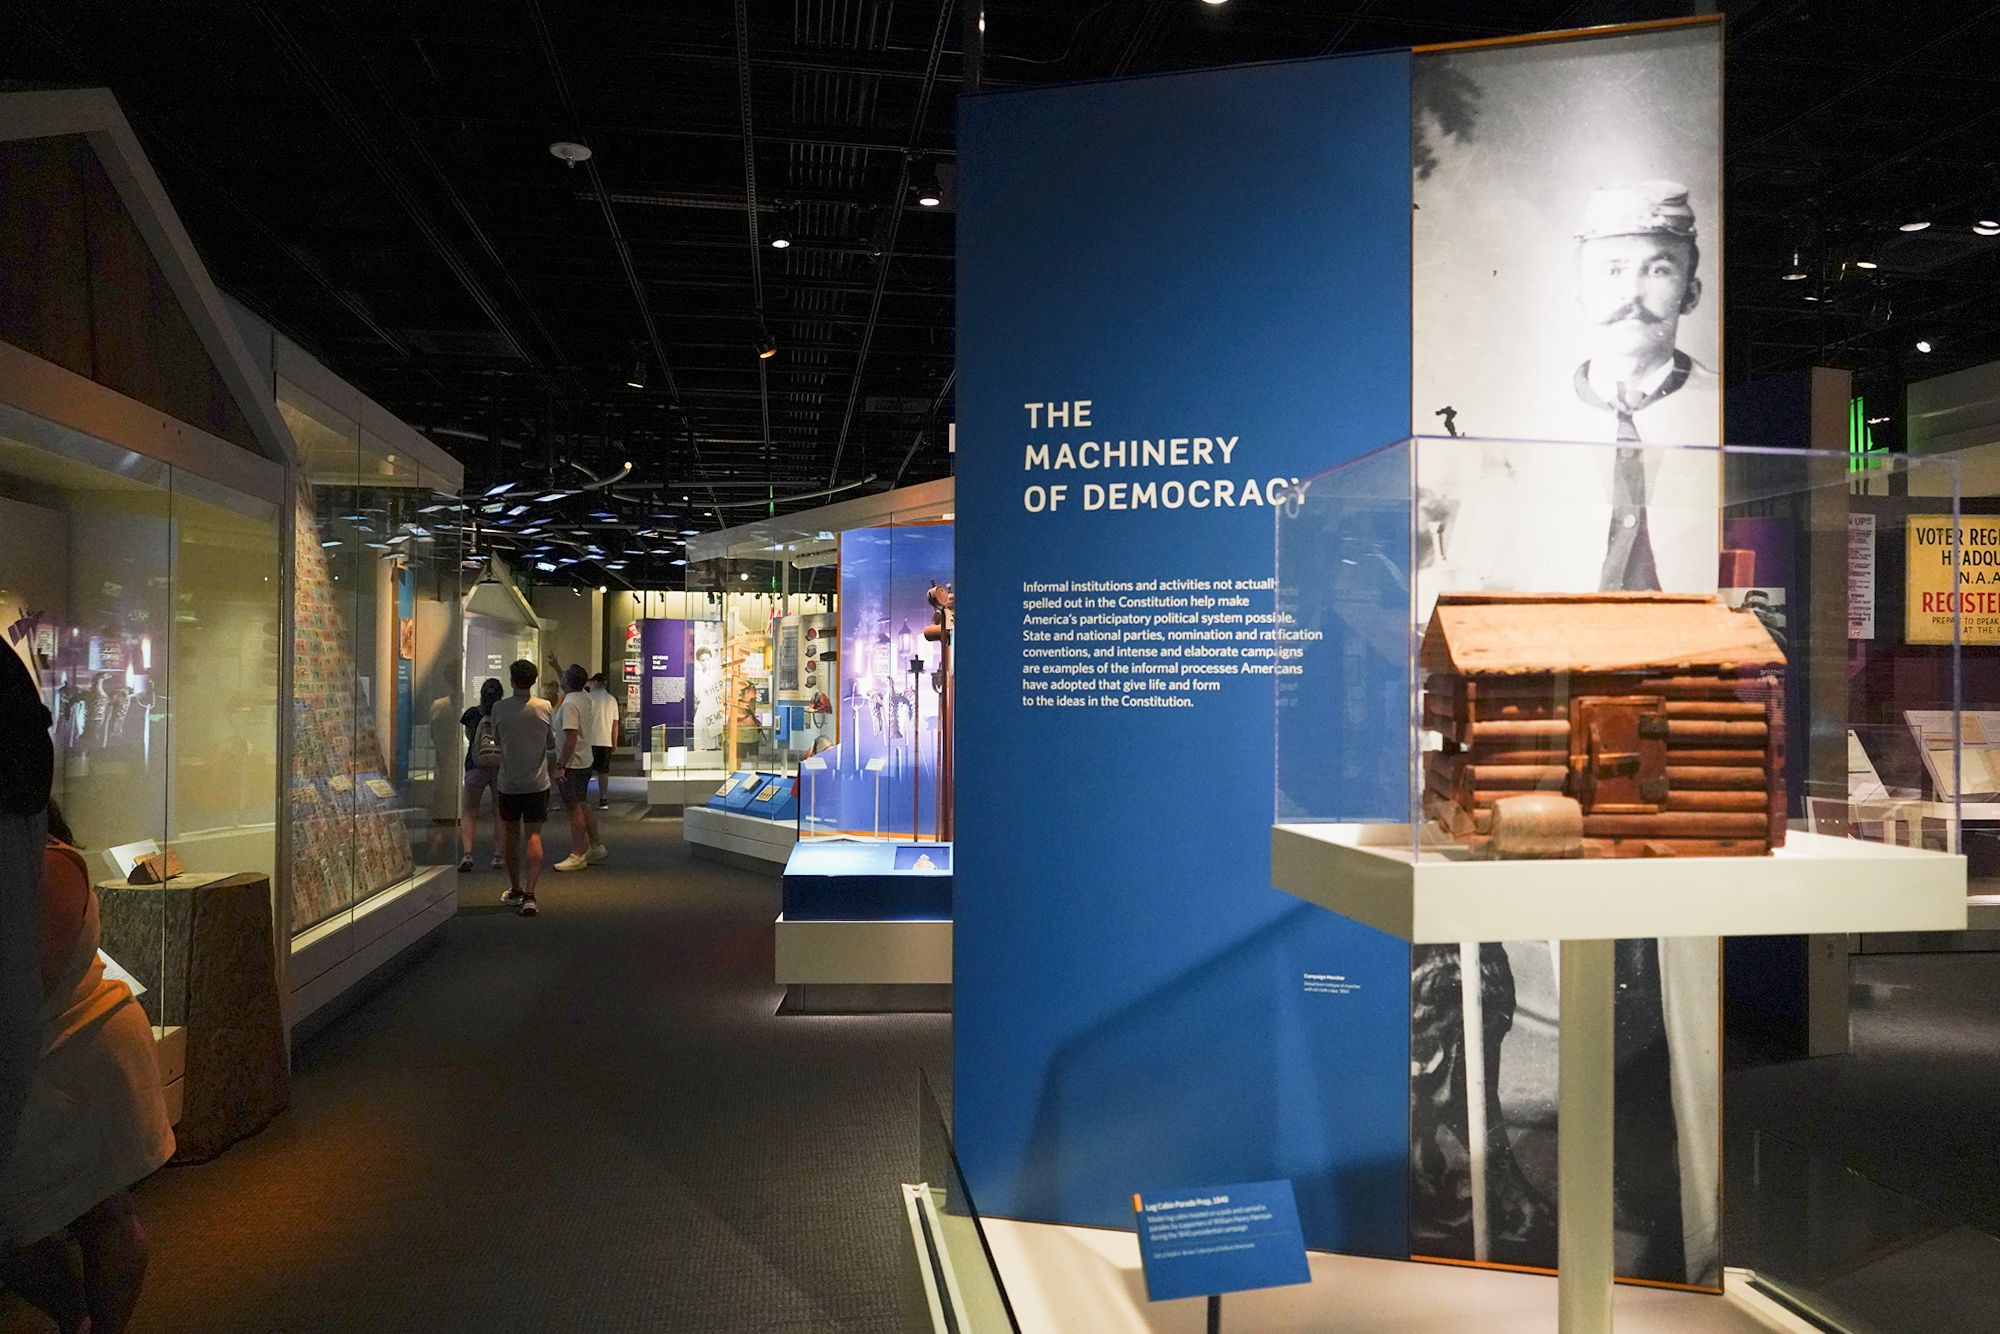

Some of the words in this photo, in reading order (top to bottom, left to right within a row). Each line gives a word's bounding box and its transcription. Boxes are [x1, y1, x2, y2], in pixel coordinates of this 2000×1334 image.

[1024, 400, 1093, 429] THE
[1024, 436, 1240, 470] MACHINERY
[1023, 485, 1068, 513] OF
[1083, 477, 1312, 511] DEMOCRACY
[1941, 550, 2000, 567] HADQU
[1023, 582, 1069, 592] Informal
[1070, 581, 1133, 591] institutions
[1134, 580, 1157, 591] and
[1158, 579, 1211, 591] activities
[1212, 579, 1232, 590] not
[1023, 598, 1062, 609] spelled
[1063, 597, 1082, 608] out
[1084, 597, 1095, 607] in
[1097, 597, 1116, 607] the
[1117, 596, 1188, 607] Constitution
[1190, 596, 1215, 608] help
[1217, 595, 1249, 606] make
[1023, 614, 1077, 624] America's
[1079, 613, 1151, 625] participatory
[1153, 613, 1198, 625] political
[1200, 613, 1243, 625] system
[1964, 617, 1974, 626] TO
[1023, 630, 1051, 641] State
[1052, 630, 1074, 641] and
[1076, 630, 1121, 641] national
[1123, 629, 1165, 642] parties,
[1167, 629, 1233, 640] nomination
[1234, 629, 1257, 640] and
[1259, 629, 1323, 640] ratfication
[1963, 626, 1973, 634] AT
[1977, 626, 1993, 635] THE
[1023, 646, 1091, 658] conventions,
[1092, 646, 1114, 657] and
[1116, 646, 1158, 657] intense
[1159, 646, 1182, 657] and
[1183, 646, 1239, 657] elaborate
[1041, 662, 1094, 675] examples
[1096, 662, 1108, 673] of
[1109, 662, 1129, 673] the
[1131, 662, 1178, 673] informal
[1180, 662, 1238, 675] processes
[1240, 662, 1303, 673] Amercans
[1023, 679, 1048, 690] have
[1049, 679, 1096, 692] adopted
[1097, 679, 1121, 690] that
[1122, 679, 1146, 692] give
[1148, 679, 1166, 690] life
[1168, 679, 1190, 690] and
[1191, 679, 1220, 690] form
[1023, 696, 1034, 706] to
[1035, 696, 1054, 706] the
[1056, 696, 1086, 706] ideas
[1087, 696, 1098, 706] in
[1099, 696, 1119, 707] the
[1120, 696, 1194, 707] Constitution.
